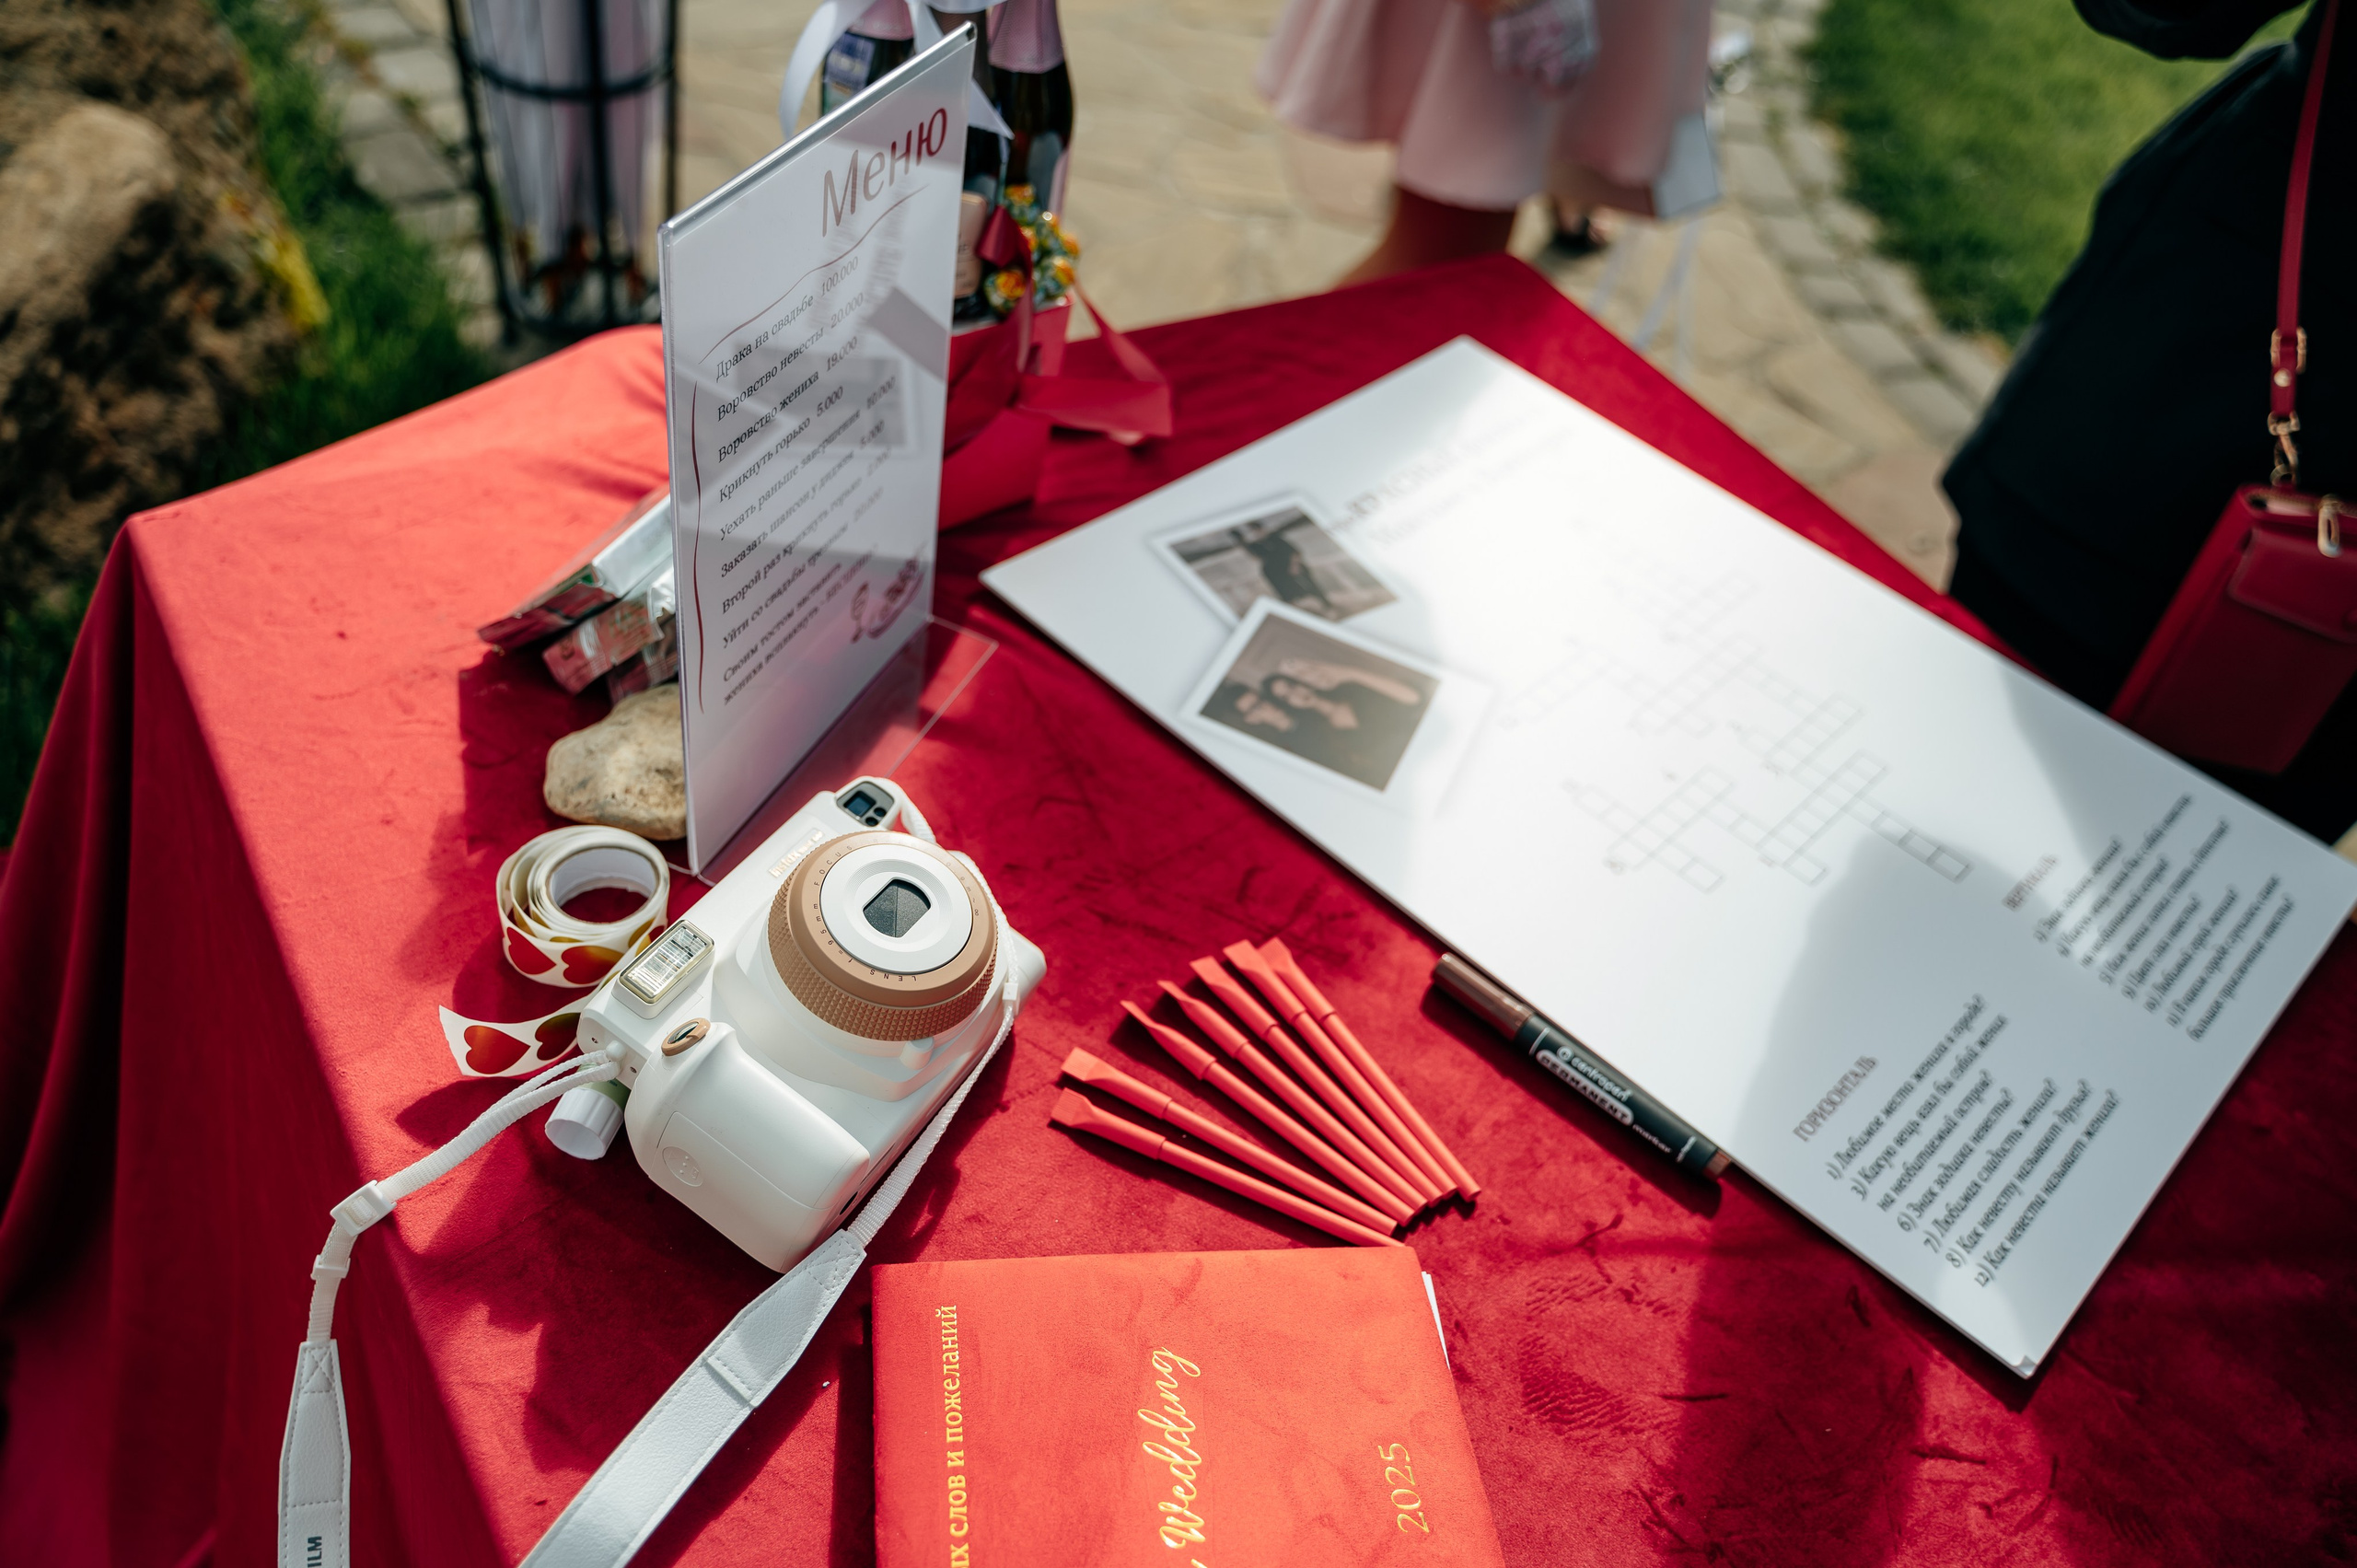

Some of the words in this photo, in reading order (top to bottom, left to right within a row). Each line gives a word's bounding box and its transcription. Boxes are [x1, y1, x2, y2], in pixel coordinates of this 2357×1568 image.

[821, 107, 948, 238] Меню
[714, 339, 752, 384] Драка
[754, 328, 769, 351] на
[771, 290, 814, 339] свадьбе
[820, 254, 858, 298] 100.000
[716, 362, 777, 425] Воровство
[779, 325, 824, 372] невесты
[830, 290, 864, 331] 20.000
[717, 402, 778, 467] Воровство
[779, 367, 819, 413] жениха
[826, 333, 858, 374] 19.000
[718, 445, 773, 507] Крикнуть
[774, 412, 810, 459] горько
[816, 383, 843, 420] 5.000
[719, 498, 756, 543] Уехать
[758, 462, 799, 512] раньше
[720, 526, 768, 580] Заказать
[722, 566, 761, 618] Второй
[869, 968, 918, 982] LENS
[1791, 1051, 1880, 1144] ГОРИЗОНТАЛЬ
[935, 1305, 963, 1443] пожеланий
[946, 1451, 964, 1468] и
[1137, 1346, 1207, 1549] Wedding
[1377, 1443, 1430, 1534] 2025
[946, 1475, 969, 1537] слов
